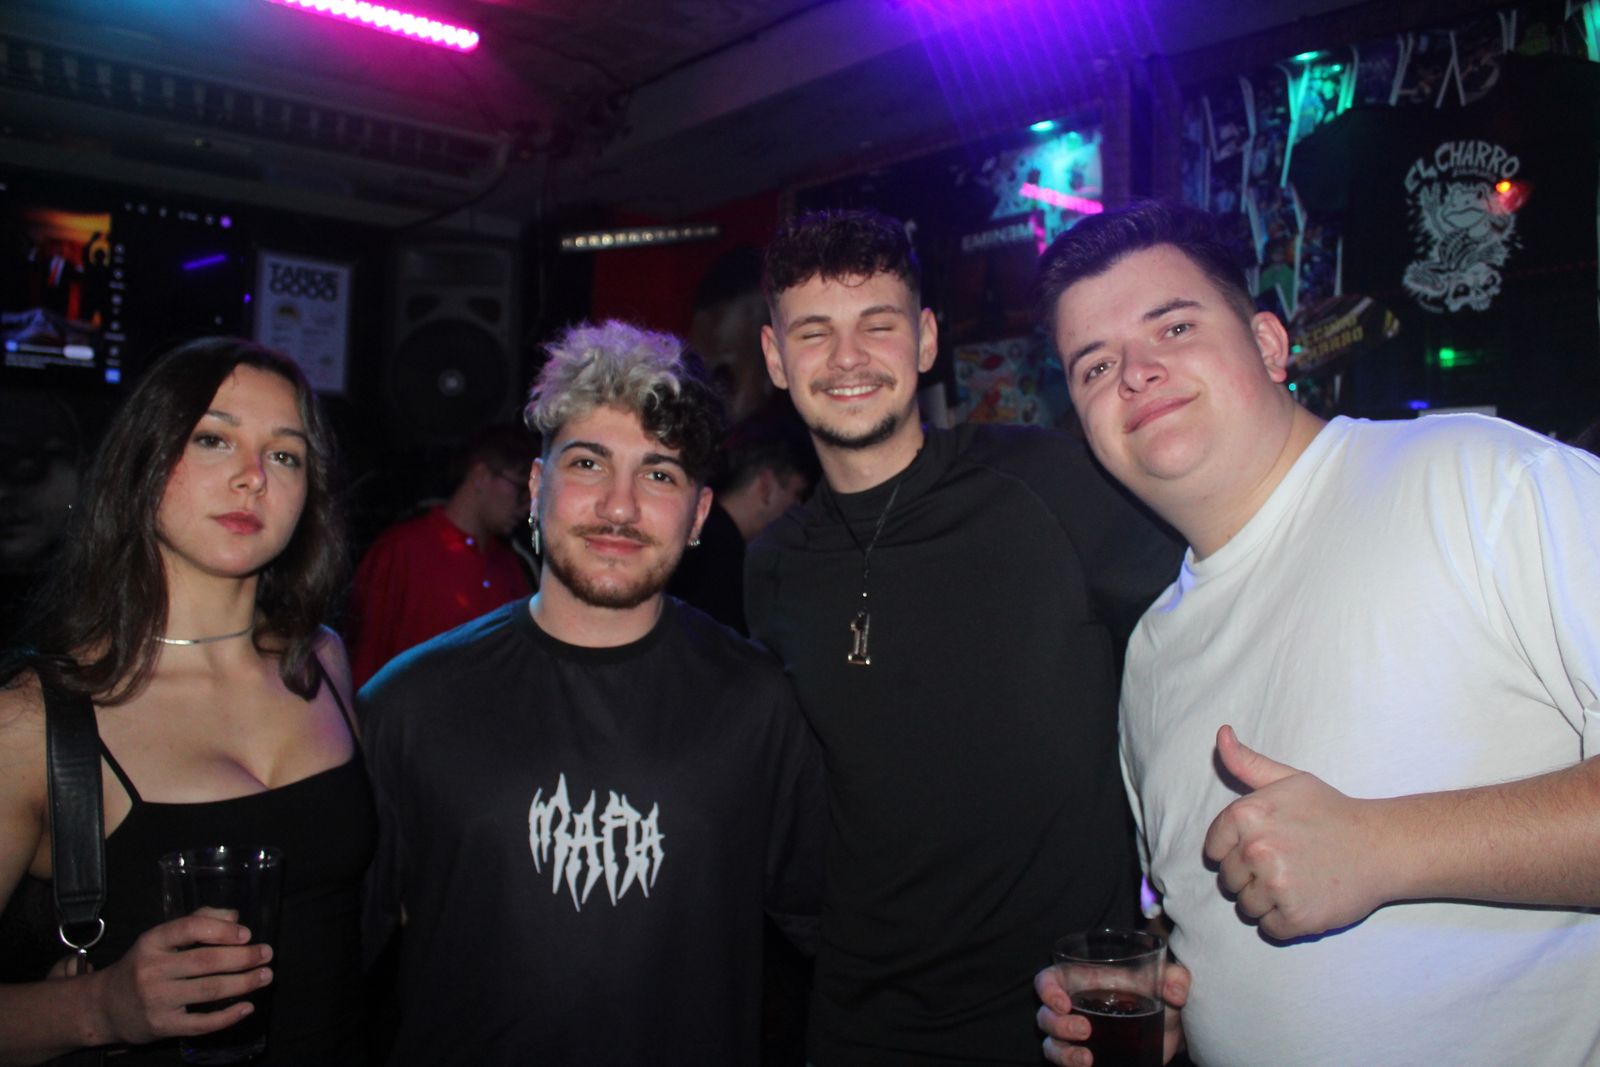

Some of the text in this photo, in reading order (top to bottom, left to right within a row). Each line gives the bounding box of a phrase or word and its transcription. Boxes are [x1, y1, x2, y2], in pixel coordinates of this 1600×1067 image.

[1404, 157, 1437, 194] EL
[1433, 139, 1521, 179] CHARRO
[528, 772, 666, 913] MAFIA
